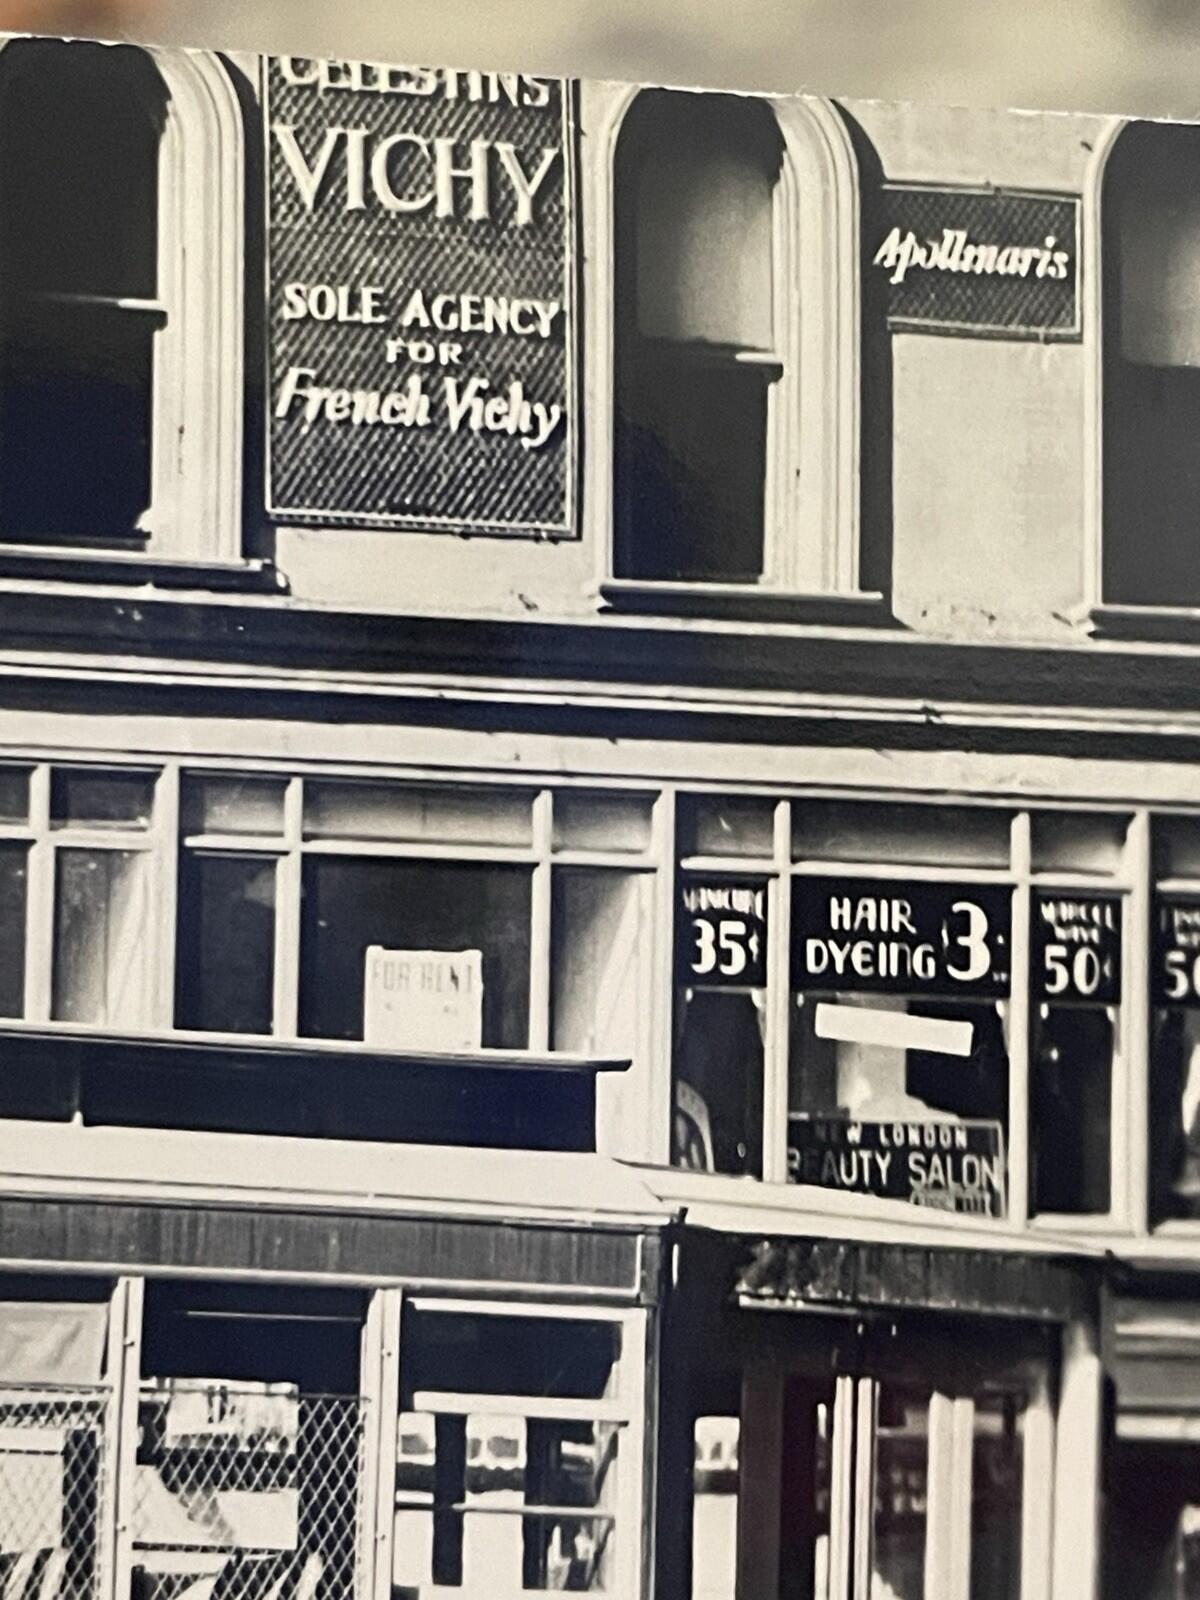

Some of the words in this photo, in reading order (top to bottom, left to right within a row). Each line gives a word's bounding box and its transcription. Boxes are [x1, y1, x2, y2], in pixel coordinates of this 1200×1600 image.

[272, 124, 559, 225] VICHY
[282, 282, 386, 323] SOLE
[402, 289, 559, 338] AGENCY
[386, 338, 463, 365] FOR
[275, 367, 431, 434] French
[444, 376, 560, 449] Vichy
[831, 896, 917, 934] HAIR
[806, 938, 936, 979] DYEING
[879, 1121, 967, 1149] LONDON
[908, 1152, 999, 1191] SALON
